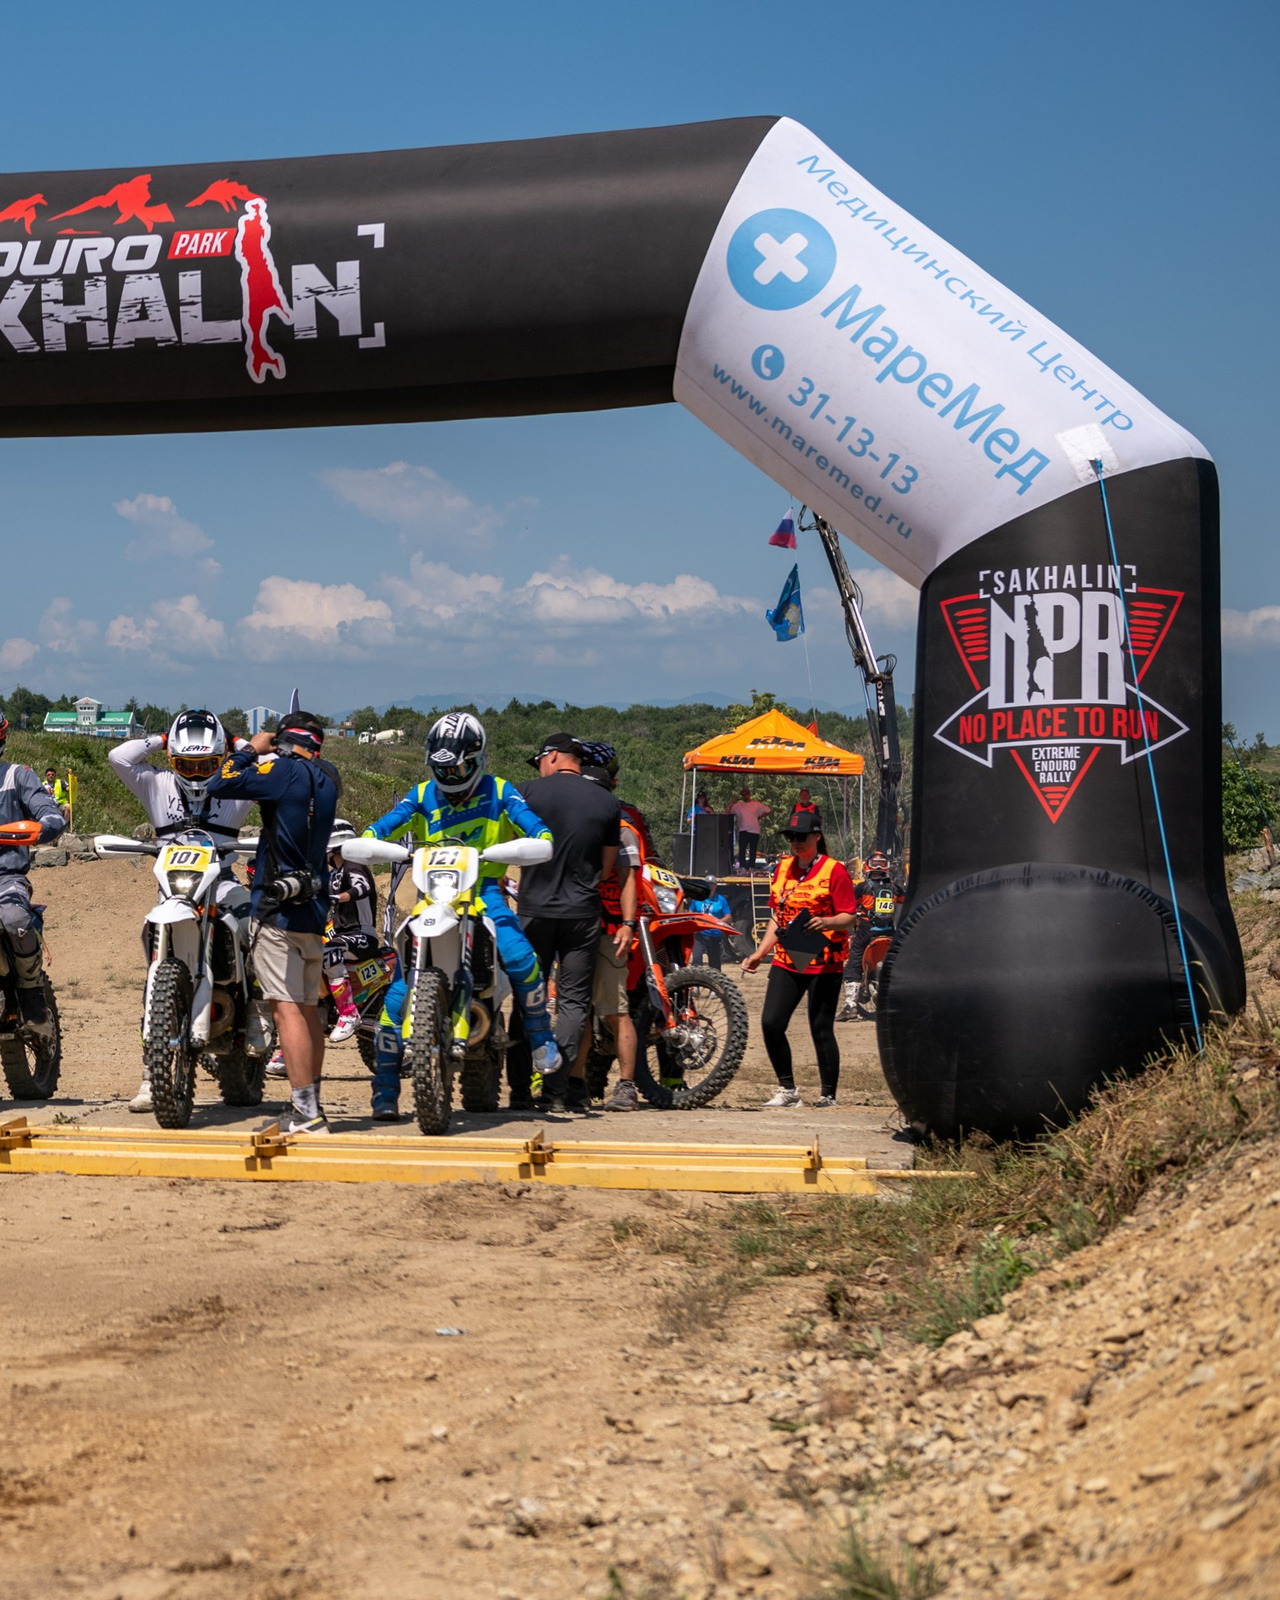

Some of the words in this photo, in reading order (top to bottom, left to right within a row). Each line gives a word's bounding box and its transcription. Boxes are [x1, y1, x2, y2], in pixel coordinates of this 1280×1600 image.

[173, 231, 225, 257] PARK
[796, 154, 1028, 341] Медицинский
[1027, 340, 1135, 432] Центр
[820, 283, 1052, 496] МареМед
[787, 375, 920, 495] 31-13-13
[712, 363, 914, 540] www.maremed.ru
[993, 564, 1121, 595] SAKHALIN
[987, 591, 1127, 709] NPR
[959, 713, 986, 745] NO
[992, 708, 1067, 741] PLACE
[1074, 707, 1105, 738] TO
[1112, 709, 1159, 741] RUN
[749, 736, 806, 749] KTM
[719, 754, 756, 766] KTM
[804, 756, 841, 767] KTM
[1032, 746, 1081, 760] EXTREME
[1035, 760, 1077, 772] ENDURO
[1039, 772, 1071, 783] RALLY
[169, 851, 201, 865] 101
[428, 850, 459, 866] 121
[878, 902, 894, 911] 146
[360, 963, 378, 982] 123
